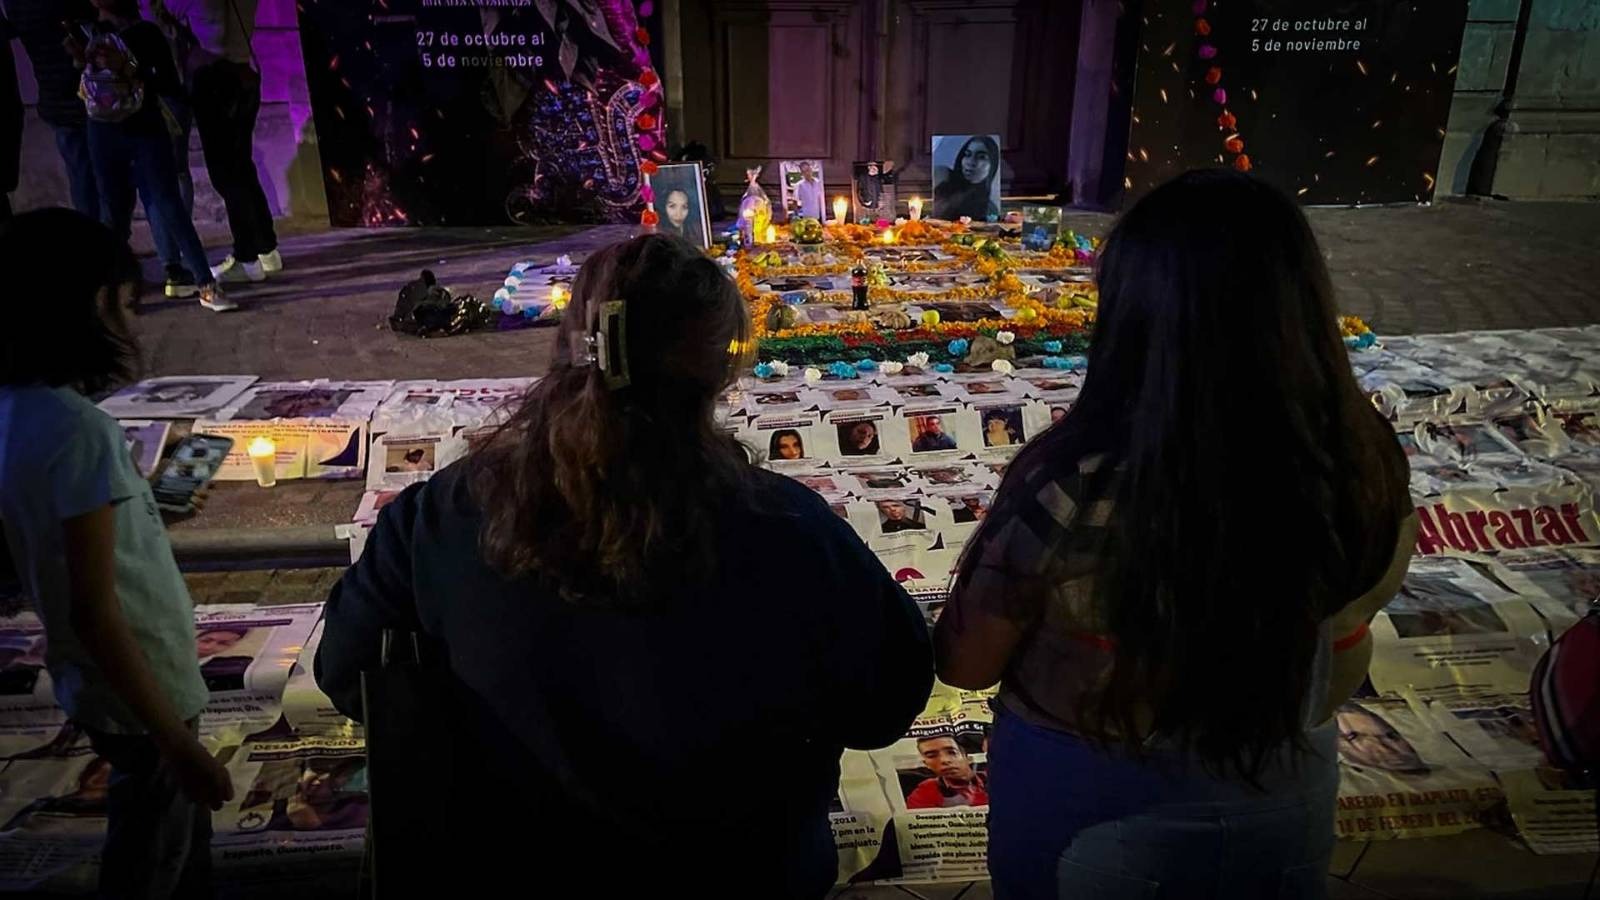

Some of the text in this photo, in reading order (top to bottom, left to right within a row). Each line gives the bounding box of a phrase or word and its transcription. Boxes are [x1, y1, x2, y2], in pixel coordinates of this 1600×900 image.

[1251, 17, 1368, 32] 27 de octubre al
[416, 31, 545, 46] 27 de octubre al
[1251, 37, 1361, 52] 5 de noviembre
[423, 53, 544, 68] 5 de noviembre
[1416, 502, 1590, 555] Abrazar
[838, 829, 853, 838] pm
